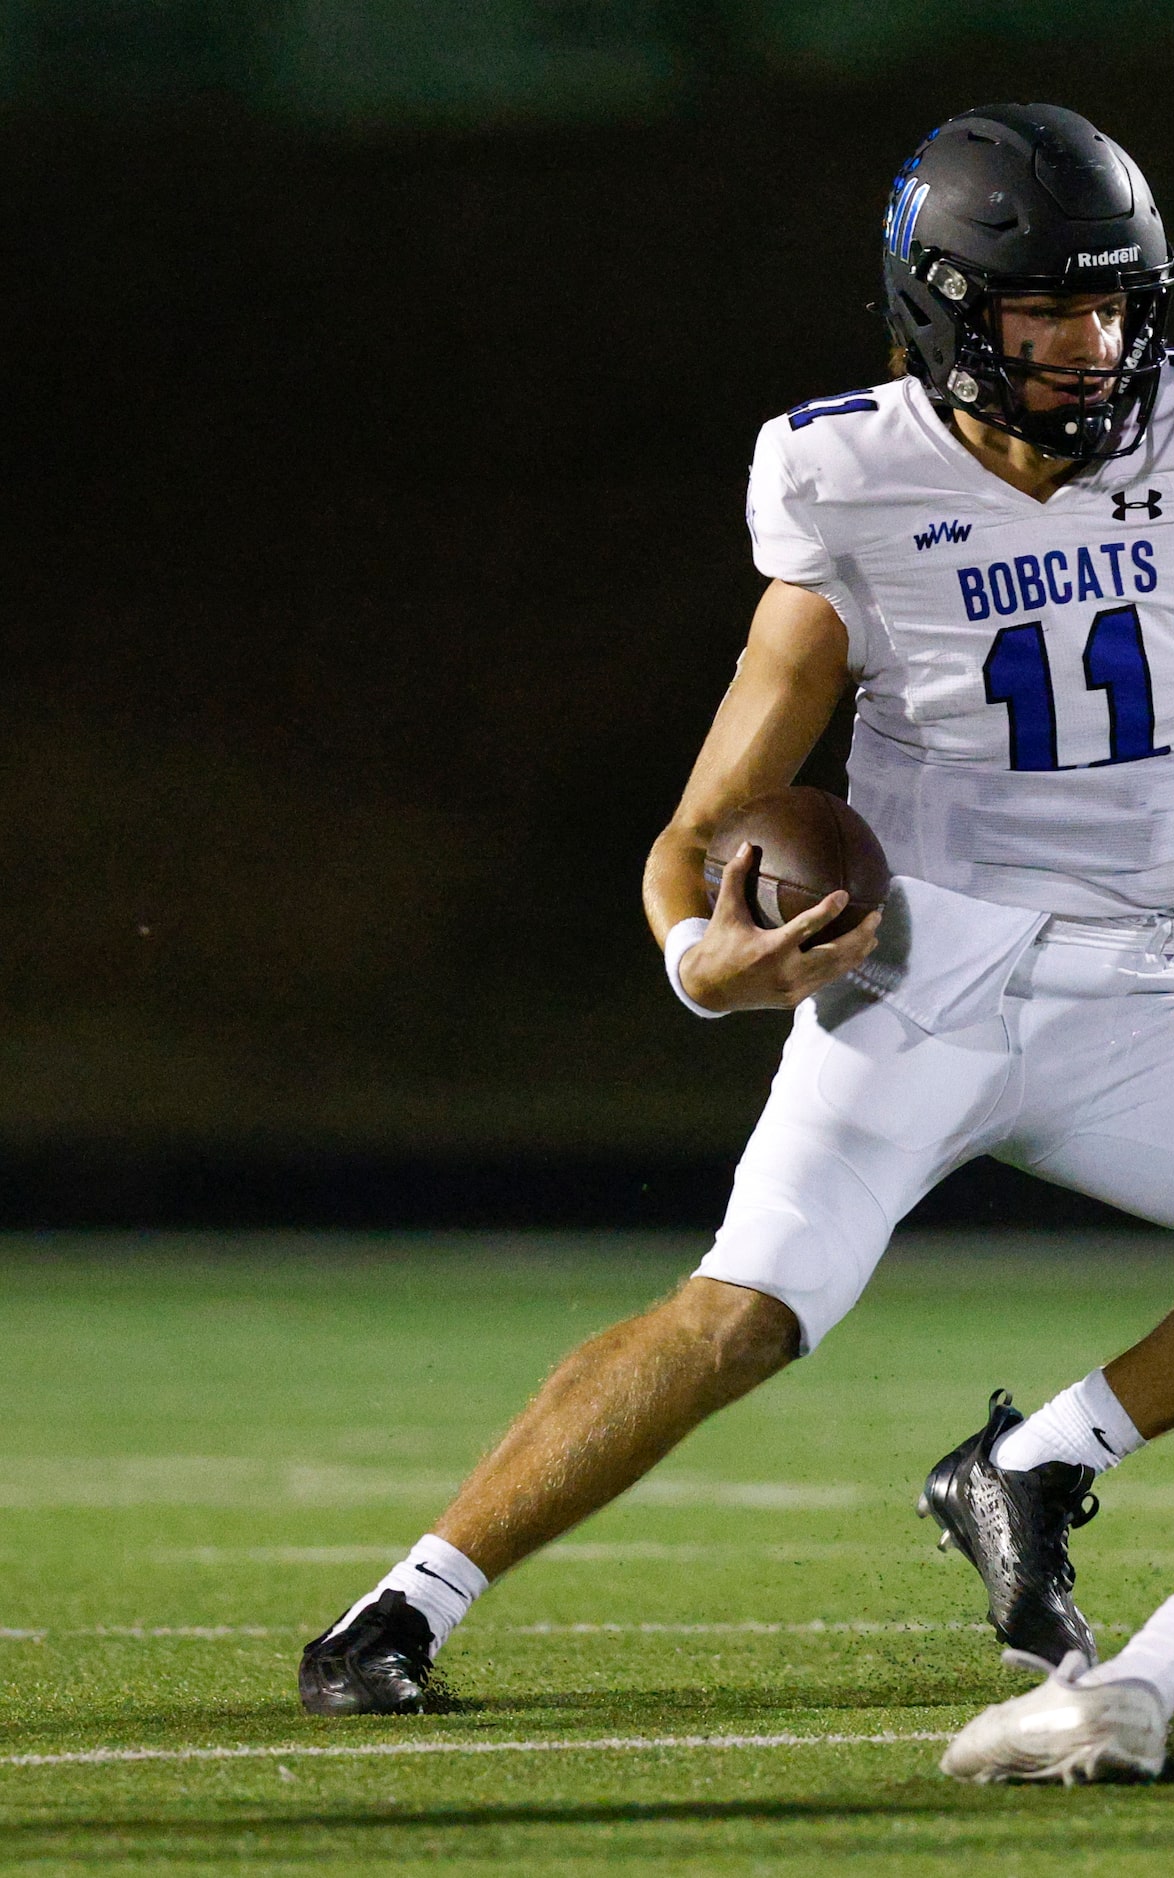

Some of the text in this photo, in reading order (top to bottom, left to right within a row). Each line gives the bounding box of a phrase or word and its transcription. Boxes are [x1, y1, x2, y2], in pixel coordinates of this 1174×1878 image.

[1077, 246, 1139, 268] Riddell
[957, 540, 1158, 622] BOBCATS
[982, 604, 1172, 772] 11
